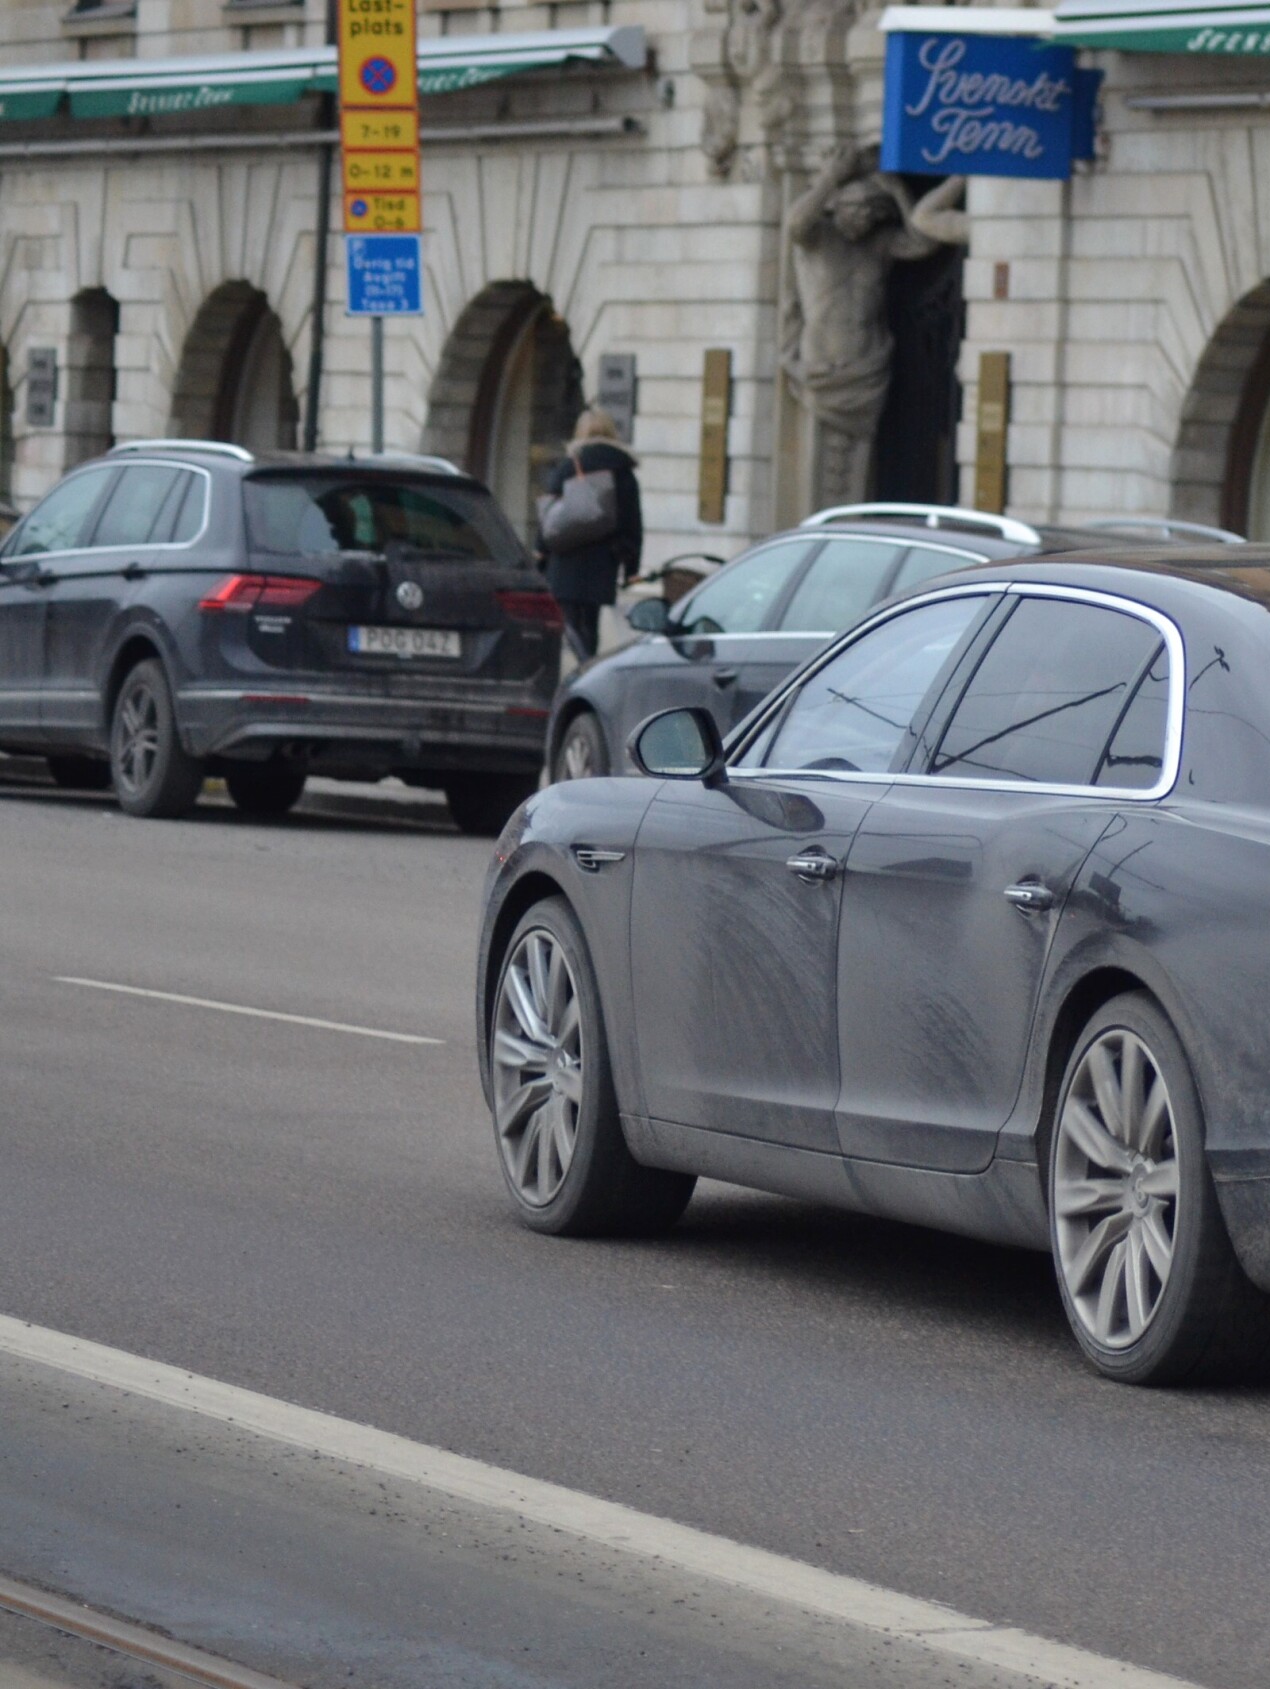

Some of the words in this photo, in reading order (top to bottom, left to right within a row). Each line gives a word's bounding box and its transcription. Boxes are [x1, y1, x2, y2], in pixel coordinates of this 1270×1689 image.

[349, 0, 405, 12] Last-
[350, 17, 404, 39] plats
[904, 37, 1072, 116] Svenskt
[361, 123, 401, 138] 7-19
[920, 106, 1044, 163] Tenn
